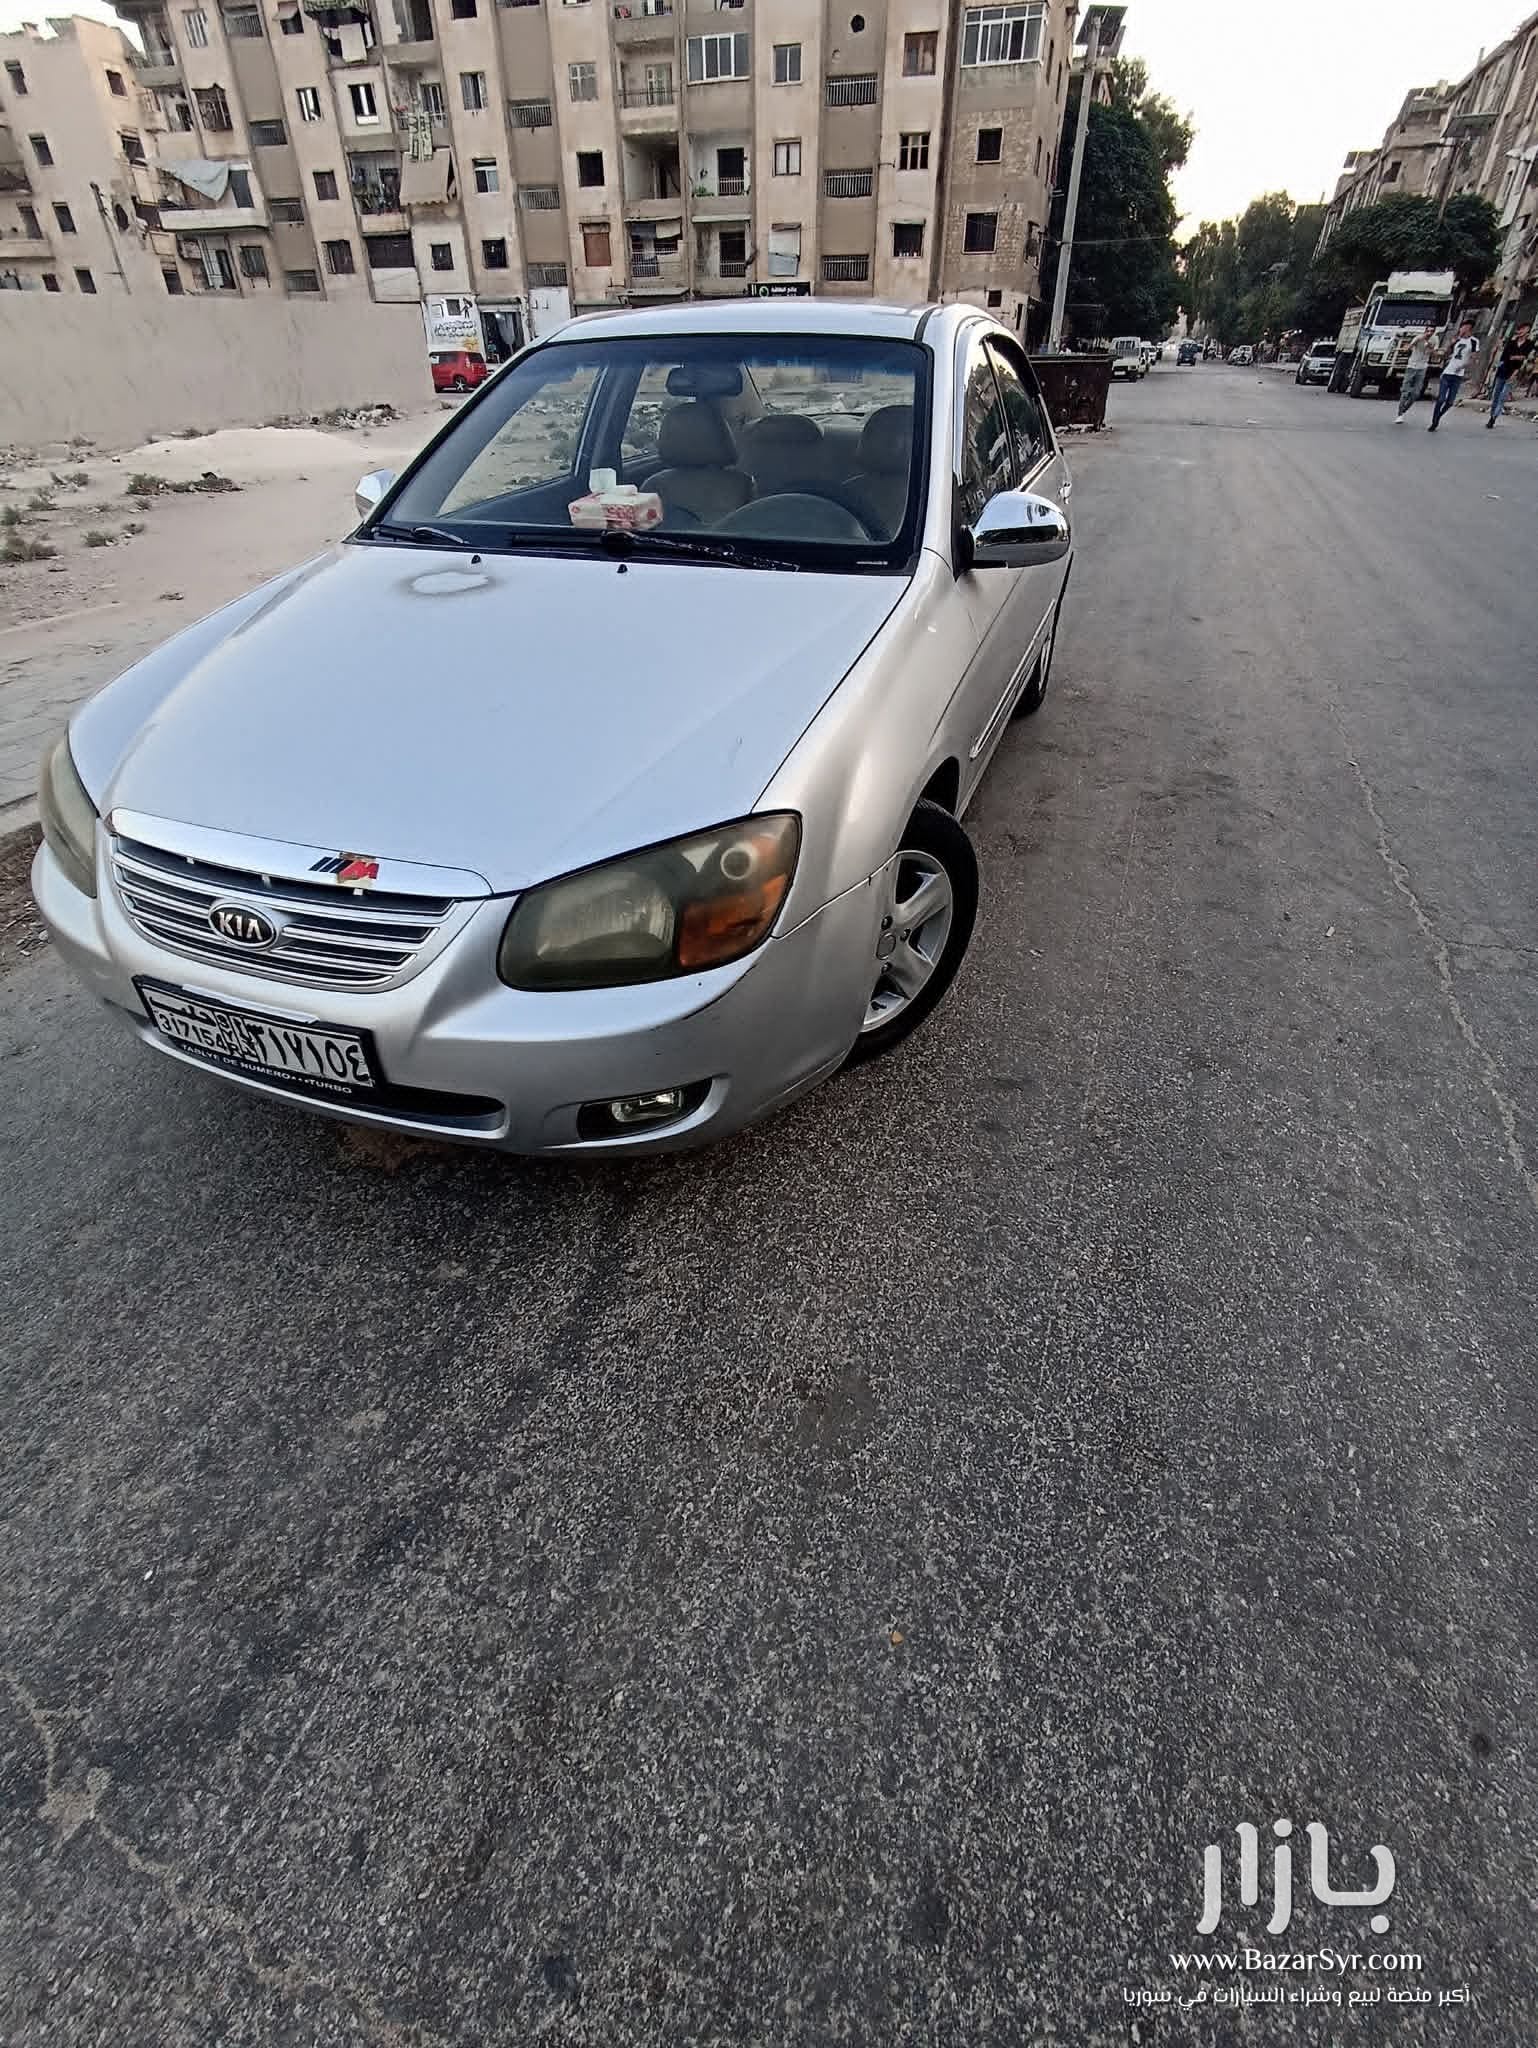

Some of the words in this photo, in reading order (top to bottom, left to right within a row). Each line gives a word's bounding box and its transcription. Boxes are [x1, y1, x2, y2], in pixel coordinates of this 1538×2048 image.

[218, 911, 263, 941] KIA
[148, 996, 217, 1028] حلب
[157, 1013, 229, 1053] 317154
